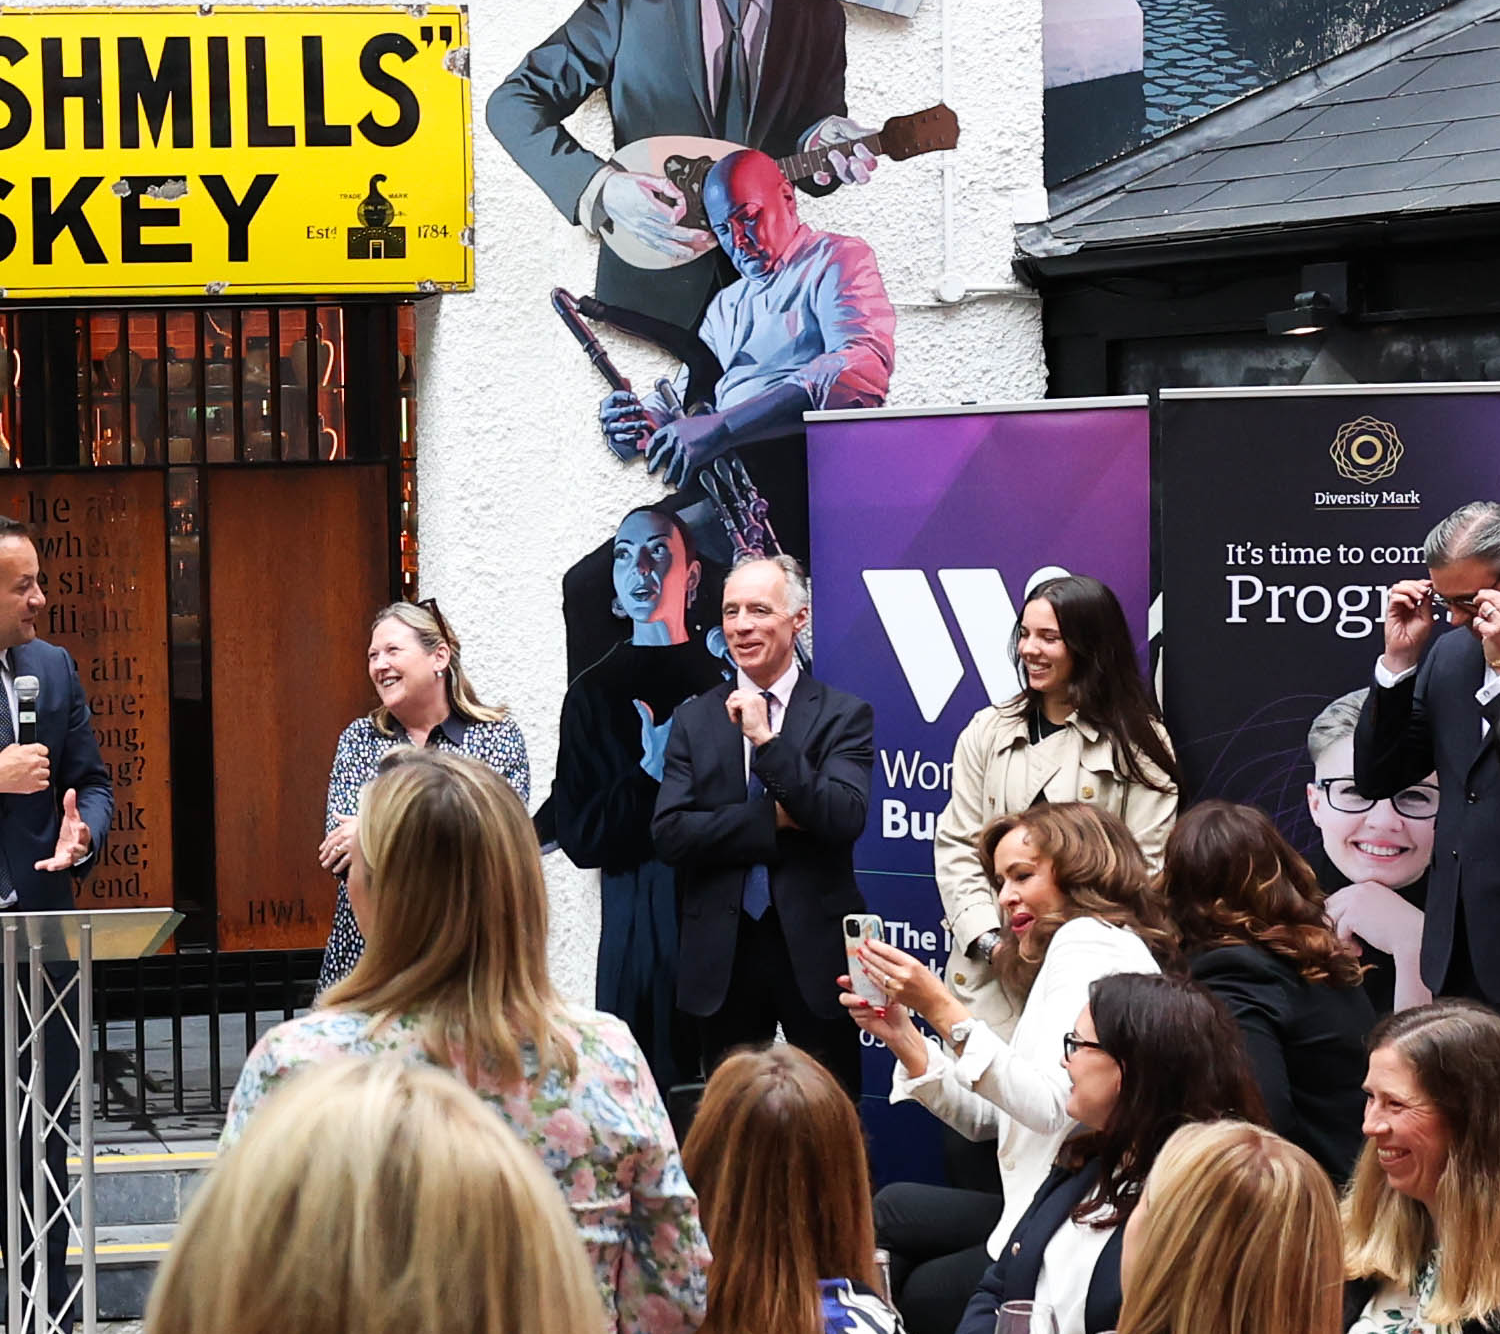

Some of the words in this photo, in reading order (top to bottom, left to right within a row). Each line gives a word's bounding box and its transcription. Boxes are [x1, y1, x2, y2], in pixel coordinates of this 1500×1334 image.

[1314, 491, 1379, 508] Diversity
[1382, 490, 1420, 504] Mark
[1226, 542, 1263, 565] It's
[1268, 541, 1332, 564] time
[1337, 543, 1364, 565] to
[1370, 544, 1426, 565] com
[90, 651, 144, 683] air,
[91, 691, 146, 717] ere;
[92, 873, 150, 900] end,
[884, 921, 936, 951] The
